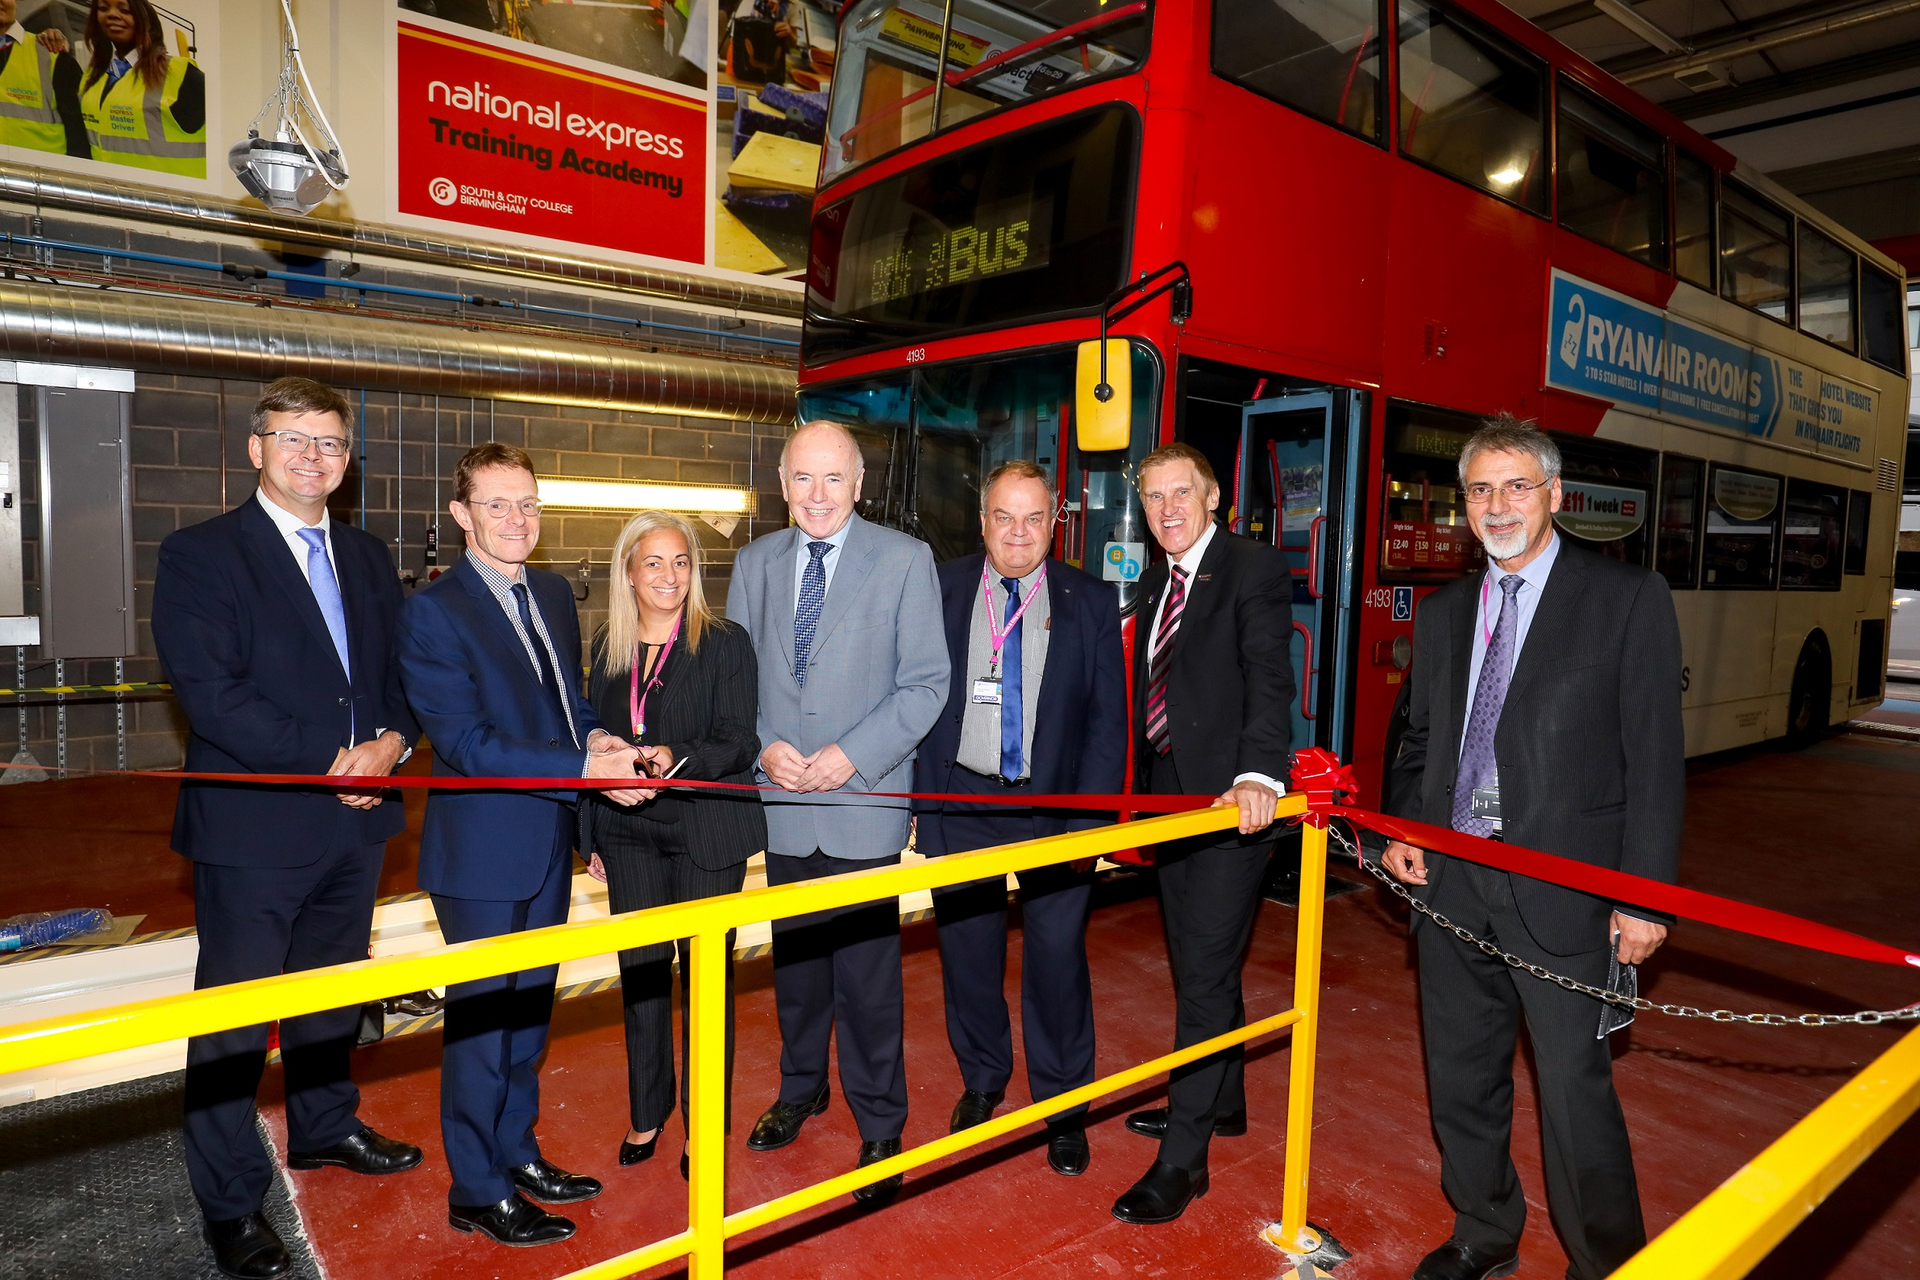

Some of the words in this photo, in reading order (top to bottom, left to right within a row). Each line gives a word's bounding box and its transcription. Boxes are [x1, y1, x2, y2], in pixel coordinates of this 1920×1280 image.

[904, 23, 966, 51] PAWNBRING
[1036, 65, 1047, 75] 16
[1050, 70, 1064, 79] 29
[110, 114, 135, 123] Master
[111, 123, 135, 132] Driver
[428, 80, 560, 131] national
[566, 112, 684, 159] express
[428, 116, 553, 171] Training
[559, 147, 683, 199] Academy
[460, 184, 496, 202] SOUTH
[497, 190, 505, 202] &
[506, 193, 528, 206] CITY
[530, 198, 573, 215] COLLEGE
[460, 195, 526, 215] BIRMINGHAM
[906, 348, 926, 363] 4193
[1586, 313, 1691, 388] RYANAIR
[1693, 351, 1762, 407] ROOMS
[1585, 365, 1590, 378] 3
[1590, 367, 1598, 380] TO
[1598, 369, 1603, 382] 5
[1603, 371, 1617, 385] STAR
[1617, 375, 1637, 391] HOTELS
[1643, 382, 1658, 397] OVER
[1679, 393, 1696, 407] ROOMS
[1700, 399, 1711, 411] FREE
[1711, 401, 1740, 418] CANCELLATION
[1788, 367, 1803, 389] THE
[1820, 380, 1844, 403] HOTEL
[1845, 388, 1872, 412] WEBSITE
[1788, 392, 1807, 413] THAT
[1807, 398, 1826, 421] GIVES
[1827, 405, 1843, 425] YOU
[1795, 419, 1804, 438] IN
[1804, 422, 1834, 446] RYANAIR
[1834, 430, 1861, 453] FLIGHTS
[1562, 490, 1584, 513] £11
[1587, 495, 1592, 511] 1
[1594, 498, 1619, 514] week
[1393, 523, 1403, 531] single
[1393, 539, 1409, 550] £2.40
[1415, 540, 1429, 551] £1.50
[1365, 589, 1391, 608] 4193
